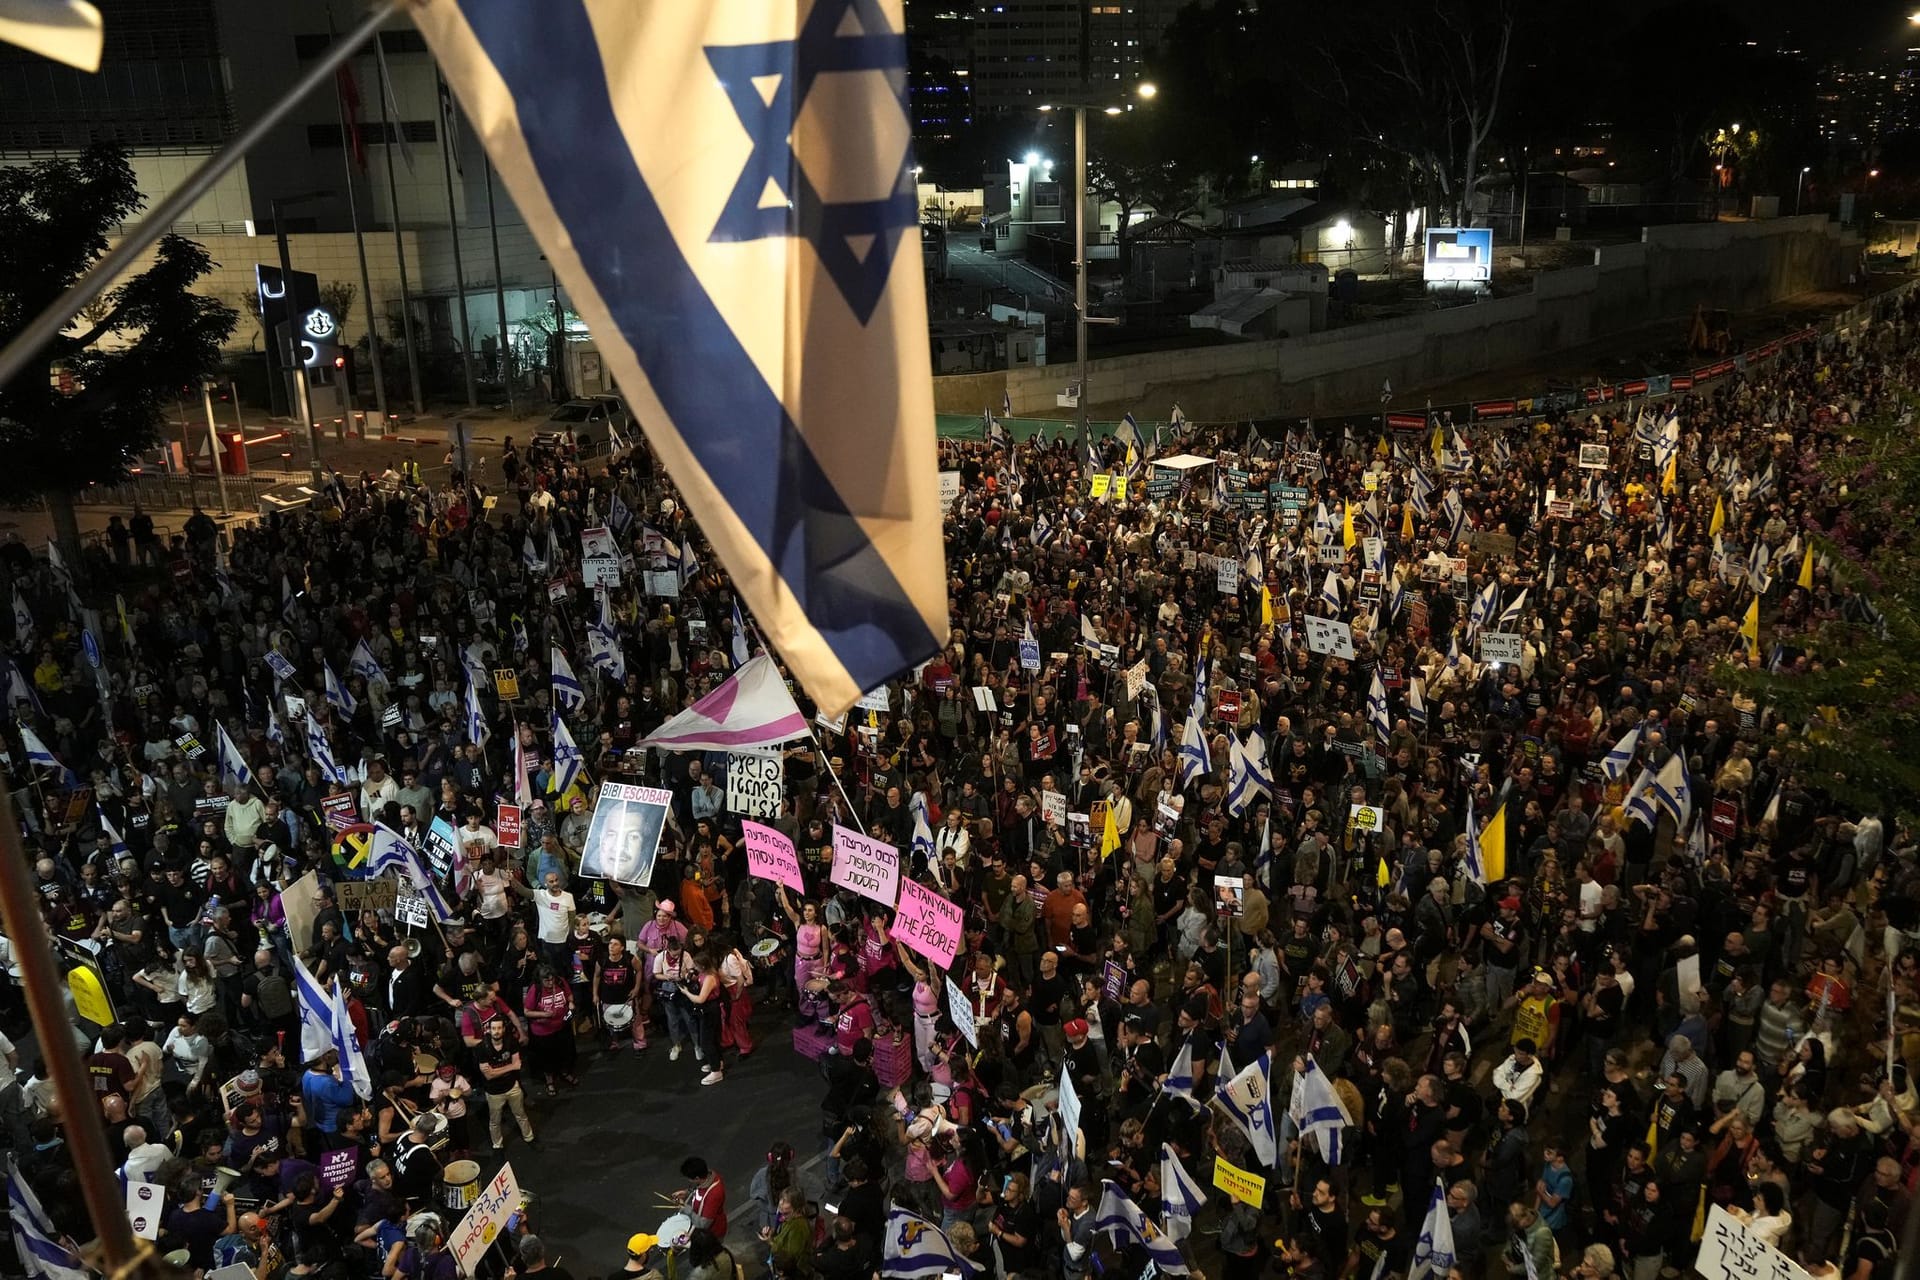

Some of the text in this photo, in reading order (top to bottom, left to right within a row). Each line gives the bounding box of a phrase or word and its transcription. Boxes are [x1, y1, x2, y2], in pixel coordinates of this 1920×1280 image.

[1320, 549, 1340, 558] 414
[1220, 560, 1237, 572] 101
[495, 670, 514, 681] 7.10
[601, 783, 671, 805] BIBI ESCOBAR
[902, 879, 961, 925] NETANYAHU
[919, 906, 937, 928] VS.
[898, 911, 957, 956] THE PEOPLE
[332, 1152, 349, 1164] לא
[493, 1170, 508, 1196] אין
[1216, 1164, 1262, 1192] החזירו אותם
[1223, 1176, 1253, 1196] הביתה
